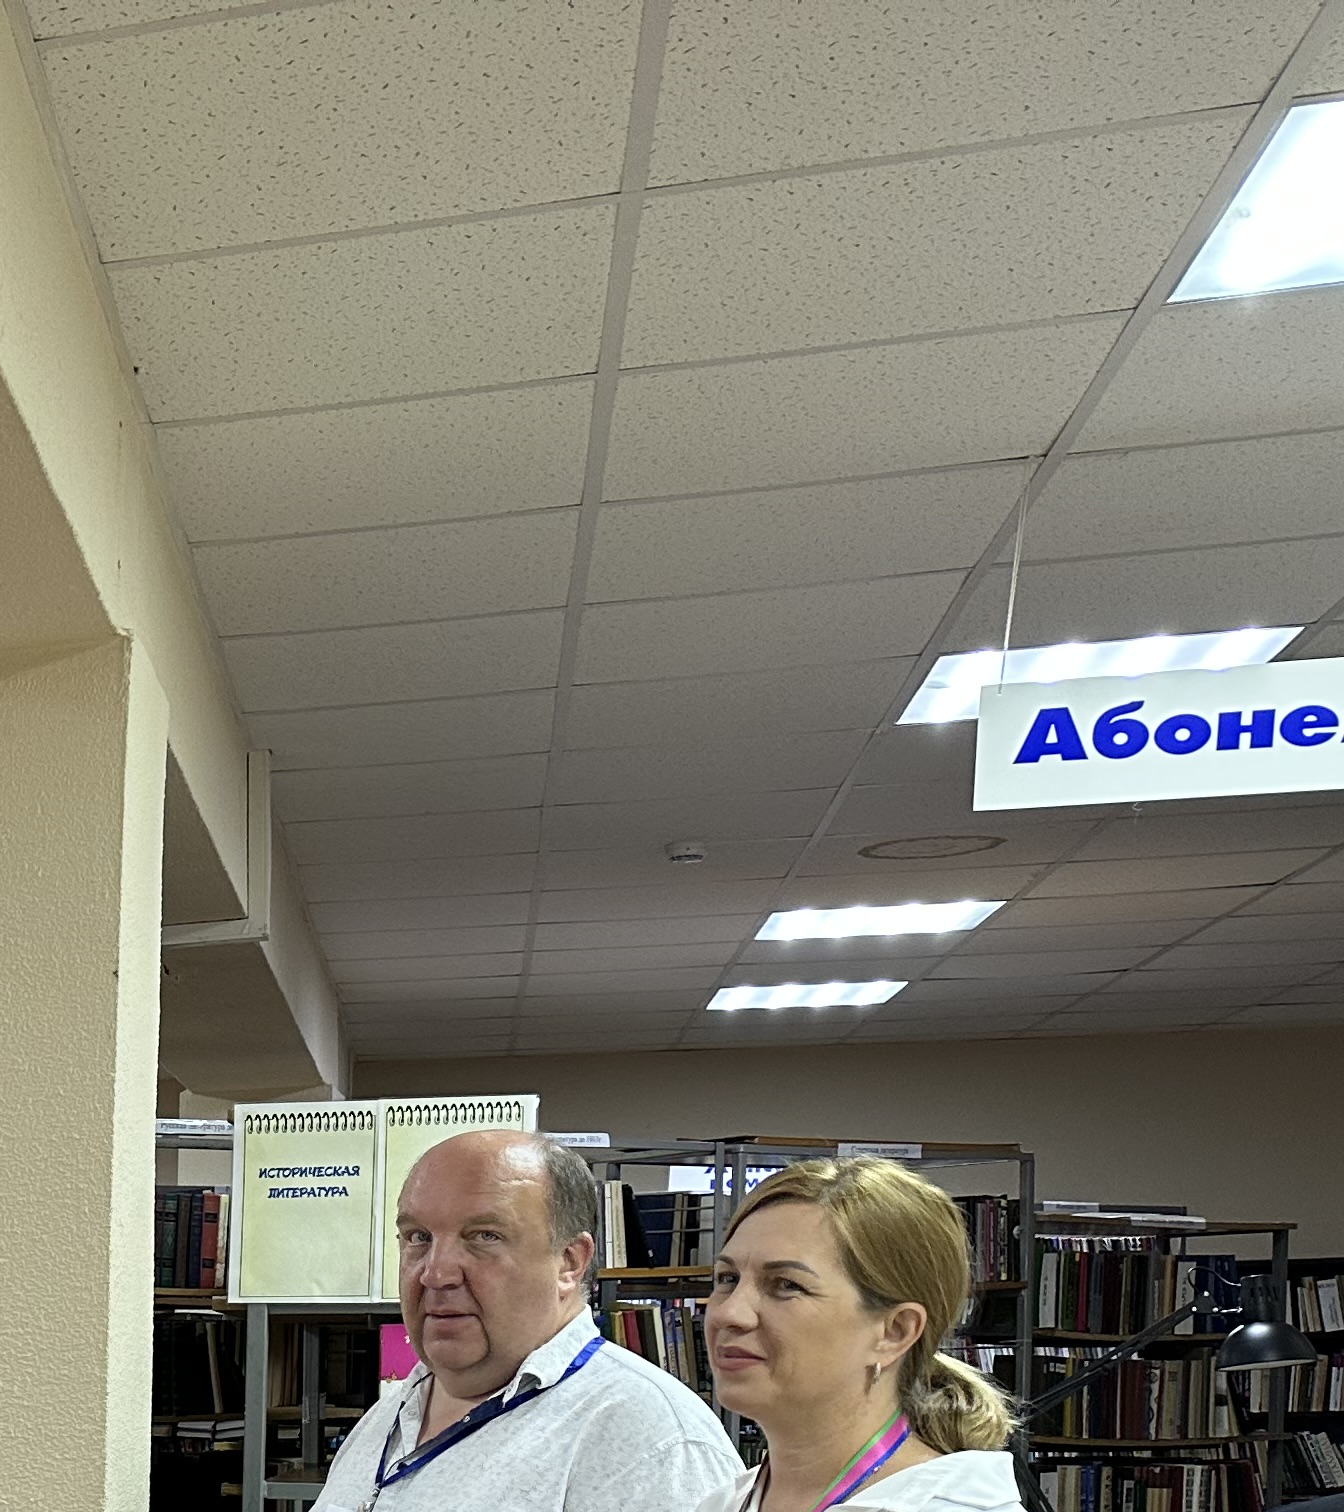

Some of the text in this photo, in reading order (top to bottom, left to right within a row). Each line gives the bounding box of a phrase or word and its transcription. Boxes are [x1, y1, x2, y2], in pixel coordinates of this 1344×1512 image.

[1012, 700, 1344, 764] Абоне
[258, 1165, 361, 1179] ИСТОРИЧЕСКАЯ
[267, 1186, 349, 1199] ЛИТЕРАТУРА
